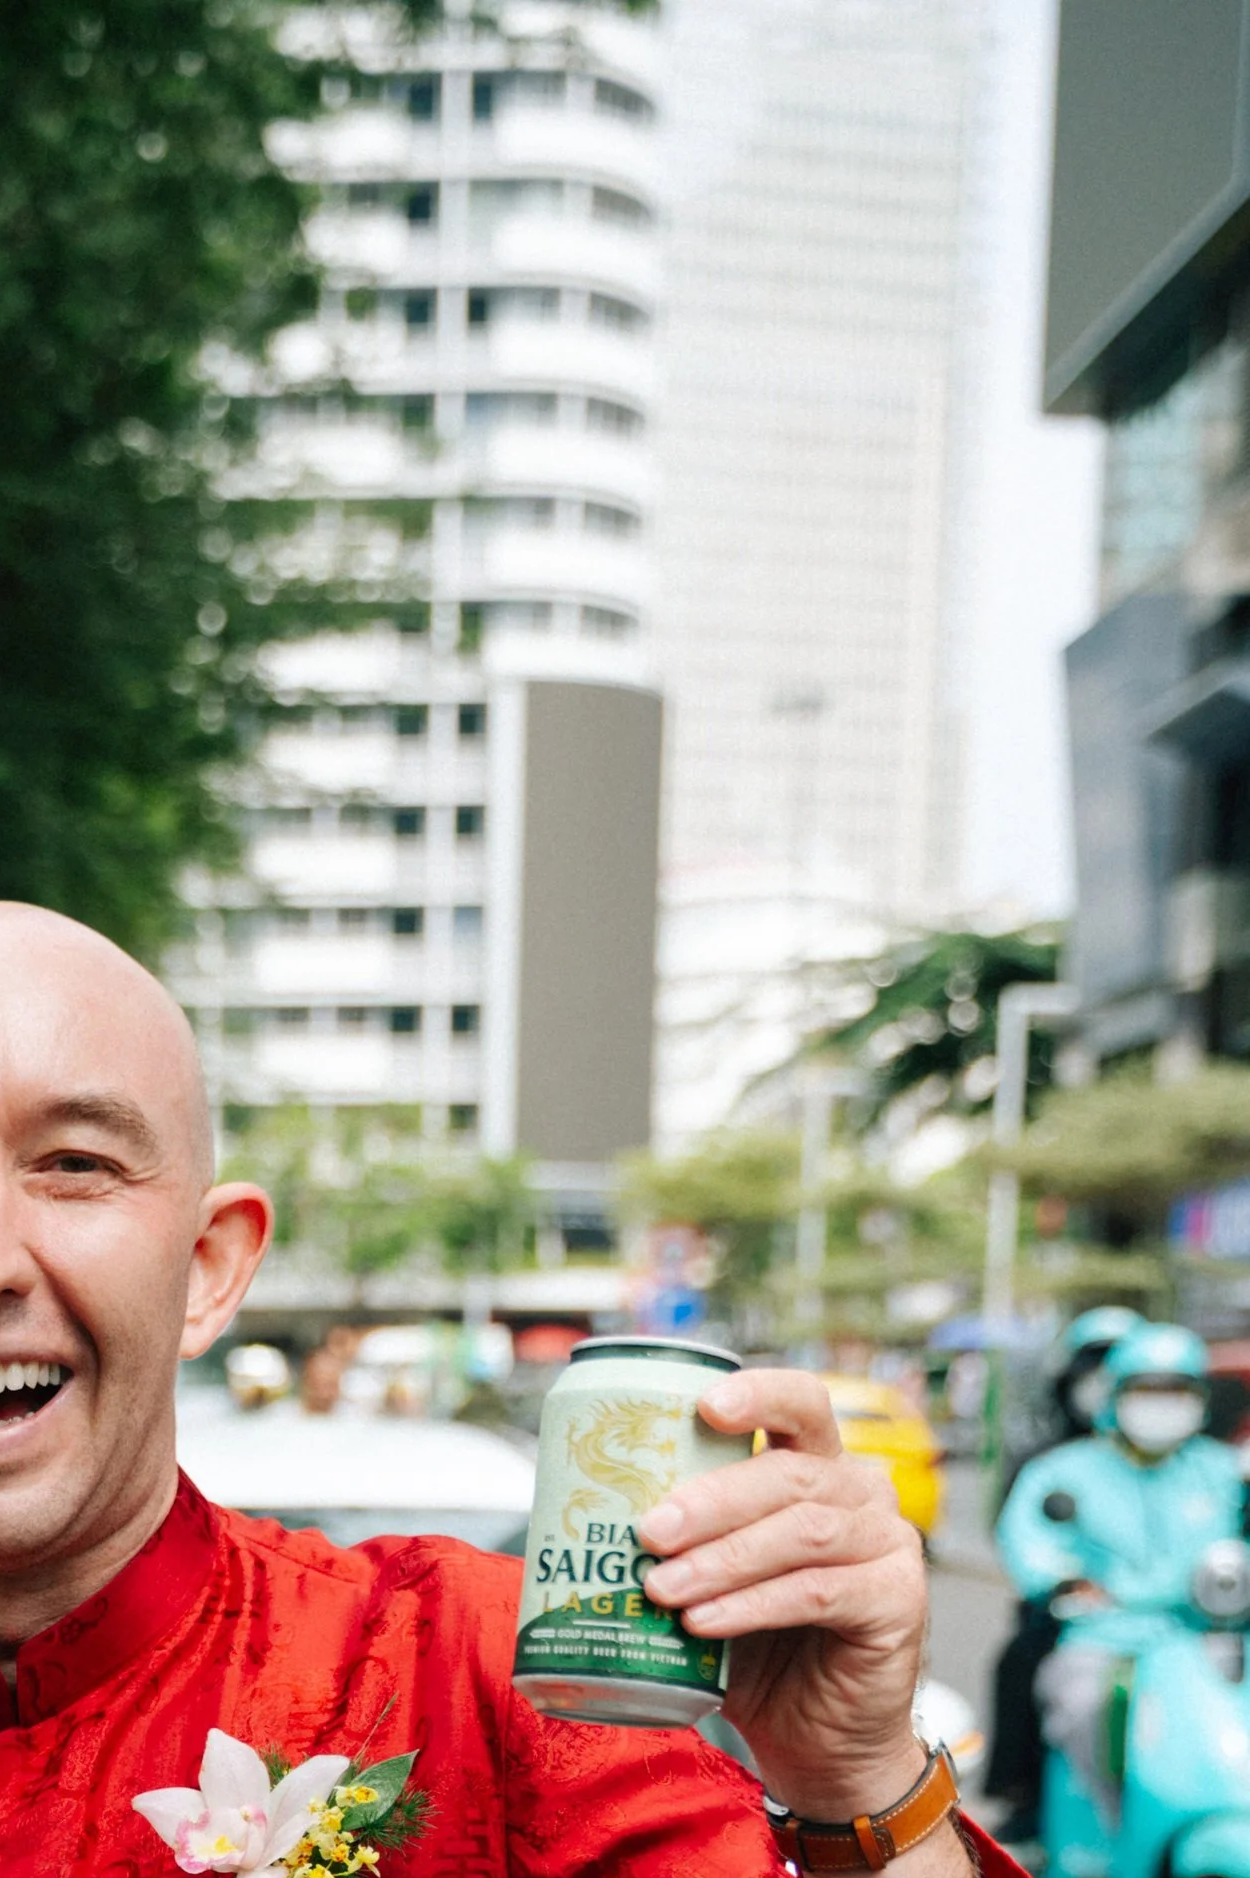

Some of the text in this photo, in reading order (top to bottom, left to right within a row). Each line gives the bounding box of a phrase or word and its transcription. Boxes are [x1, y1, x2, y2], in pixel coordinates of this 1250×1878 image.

[586, 1523, 638, 1546] BIA
[536, 1548, 662, 1587] SAIGO
[557, 1629, 582, 1640] GOLD
[583, 1630, 617, 1642] MEDAL
